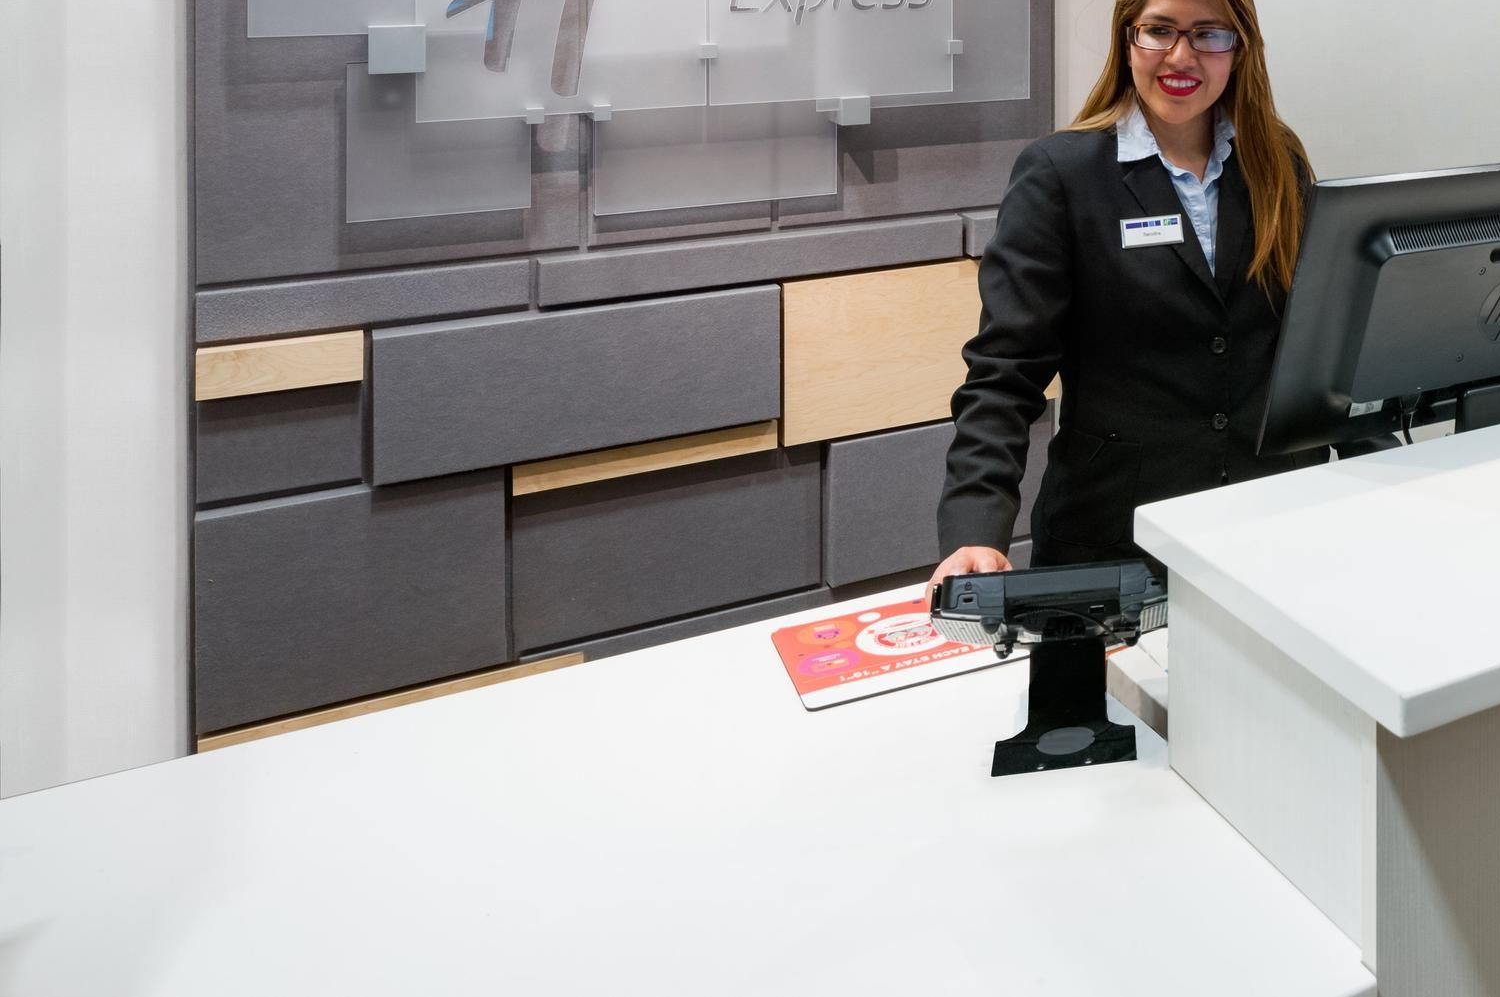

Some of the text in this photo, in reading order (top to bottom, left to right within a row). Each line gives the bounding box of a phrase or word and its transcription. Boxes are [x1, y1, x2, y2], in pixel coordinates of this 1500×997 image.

[932, 646, 970, 660] EACH
[880, 664, 891, 672] A
[895, 656, 930, 669] STAY
